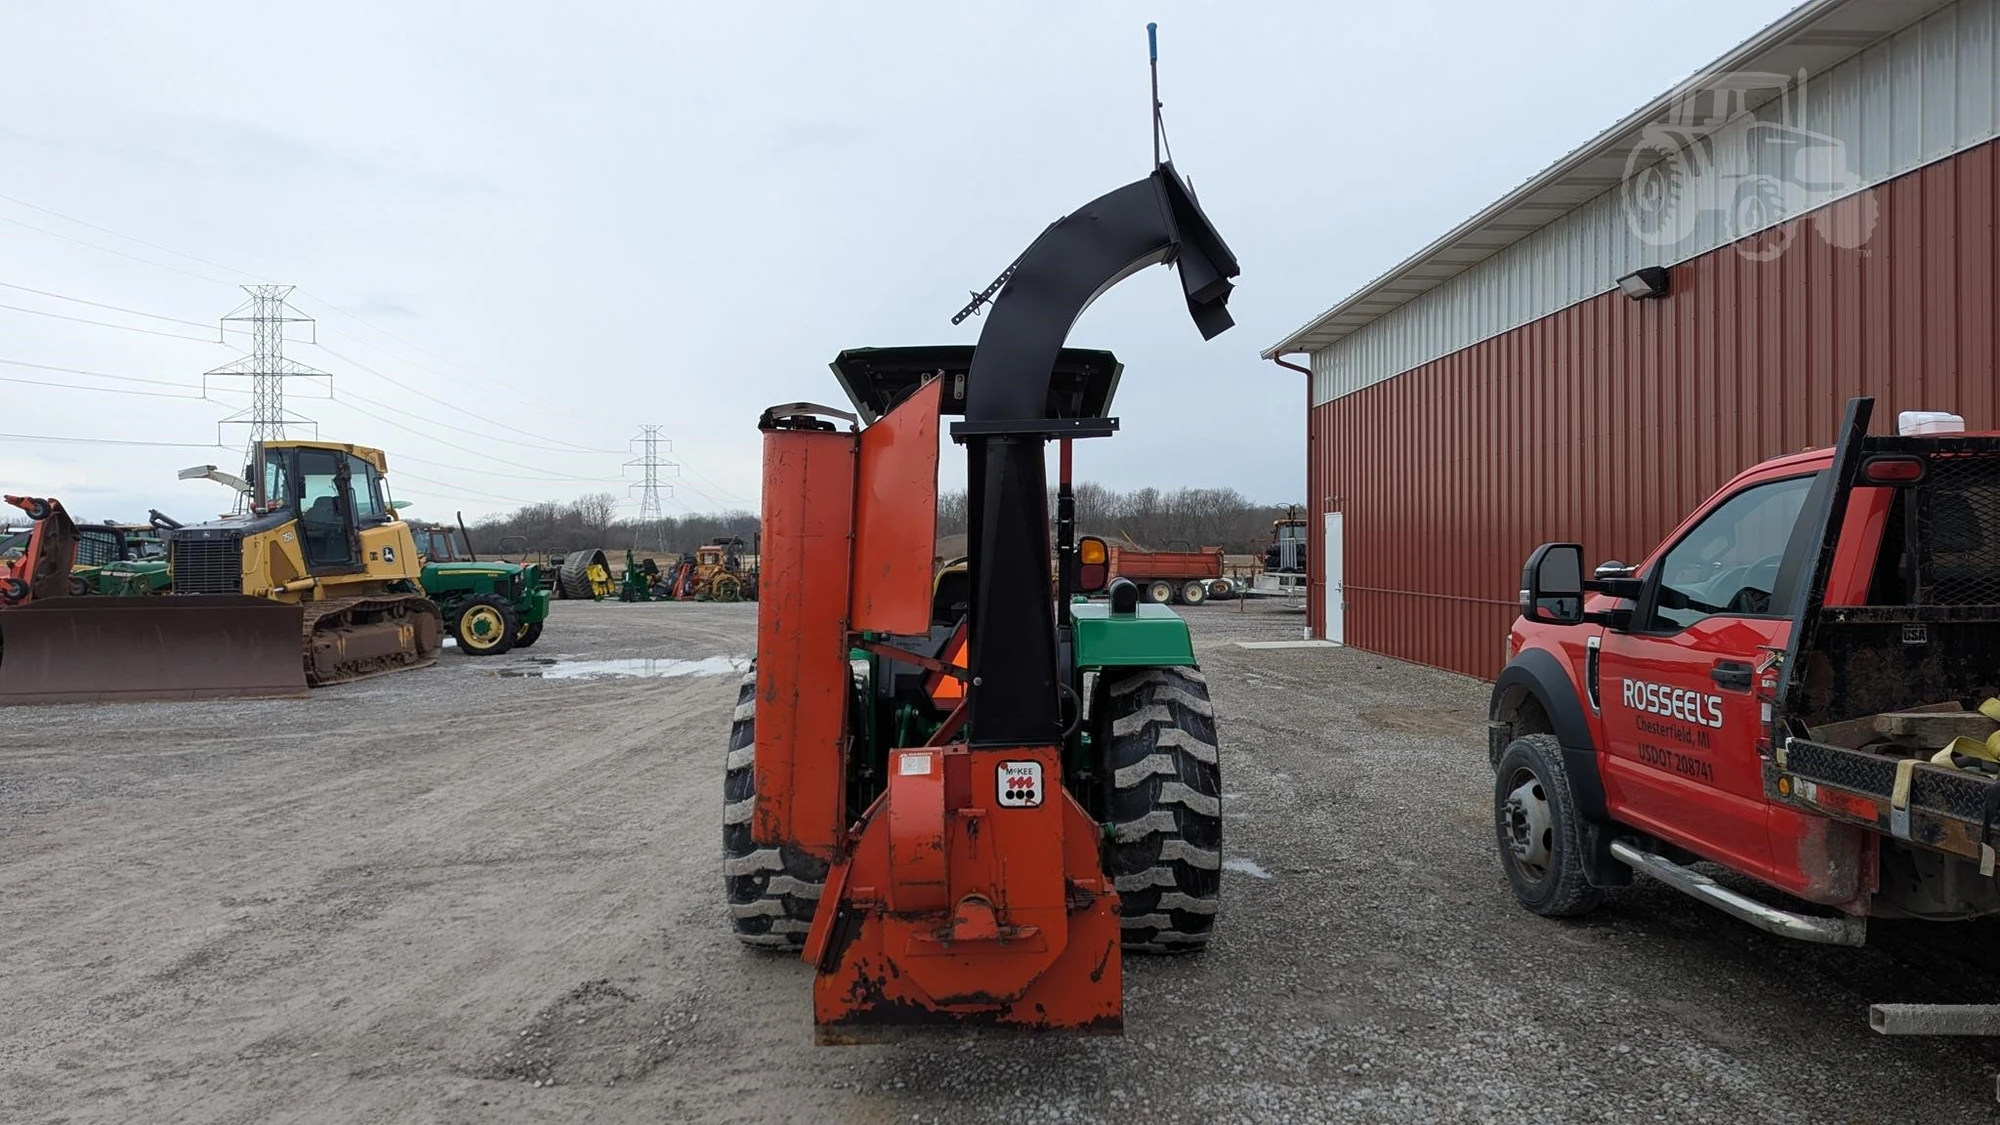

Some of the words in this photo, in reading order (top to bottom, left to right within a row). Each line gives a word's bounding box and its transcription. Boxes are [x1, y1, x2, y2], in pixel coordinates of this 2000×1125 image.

[1623, 678, 1723, 728] ROSSEEL'S
[1636, 715, 1695, 748] Chesterfield,
[1697, 730, 1710, 750] MI
[1638, 742, 1672, 769] USDOT
[1675, 752, 1714, 782] 208741
